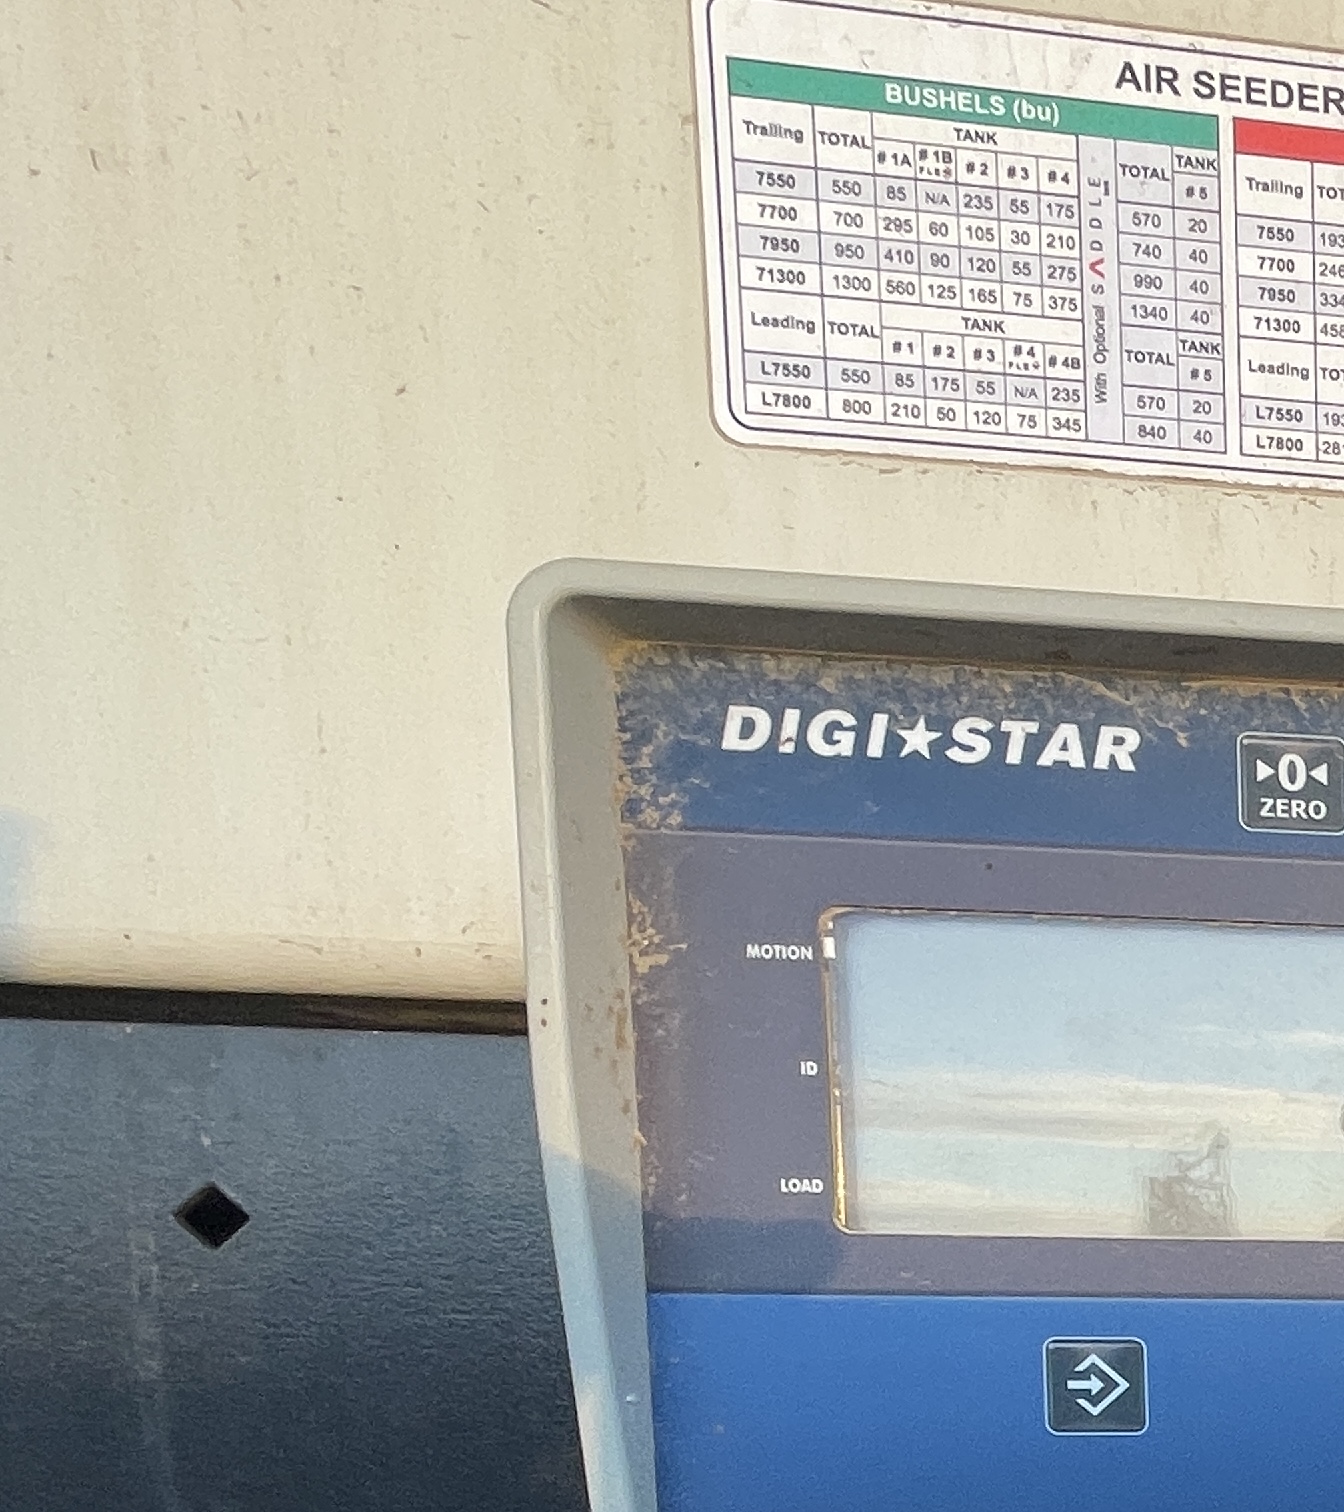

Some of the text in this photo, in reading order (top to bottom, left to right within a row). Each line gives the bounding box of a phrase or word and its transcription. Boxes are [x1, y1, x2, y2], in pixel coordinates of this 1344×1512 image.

[1116, 61, 1181, 97] AIR
[885, 82, 1061, 127] BUSHELS (bu)
[756, 171, 861, 196] 7550 550
[758, 204, 863, 228] 7700 700
[756, 267, 871, 292] 71300 1300
[760, 361, 871, 383] L7550 550
[762, 392, 811, 408] L7800
[1259, 796, 1327, 821] ZERO
[746, 944, 813, 961] MOTION
[800, 1061, 818, 1076] ID
[780, 1178, 824, 1194] LOAD
